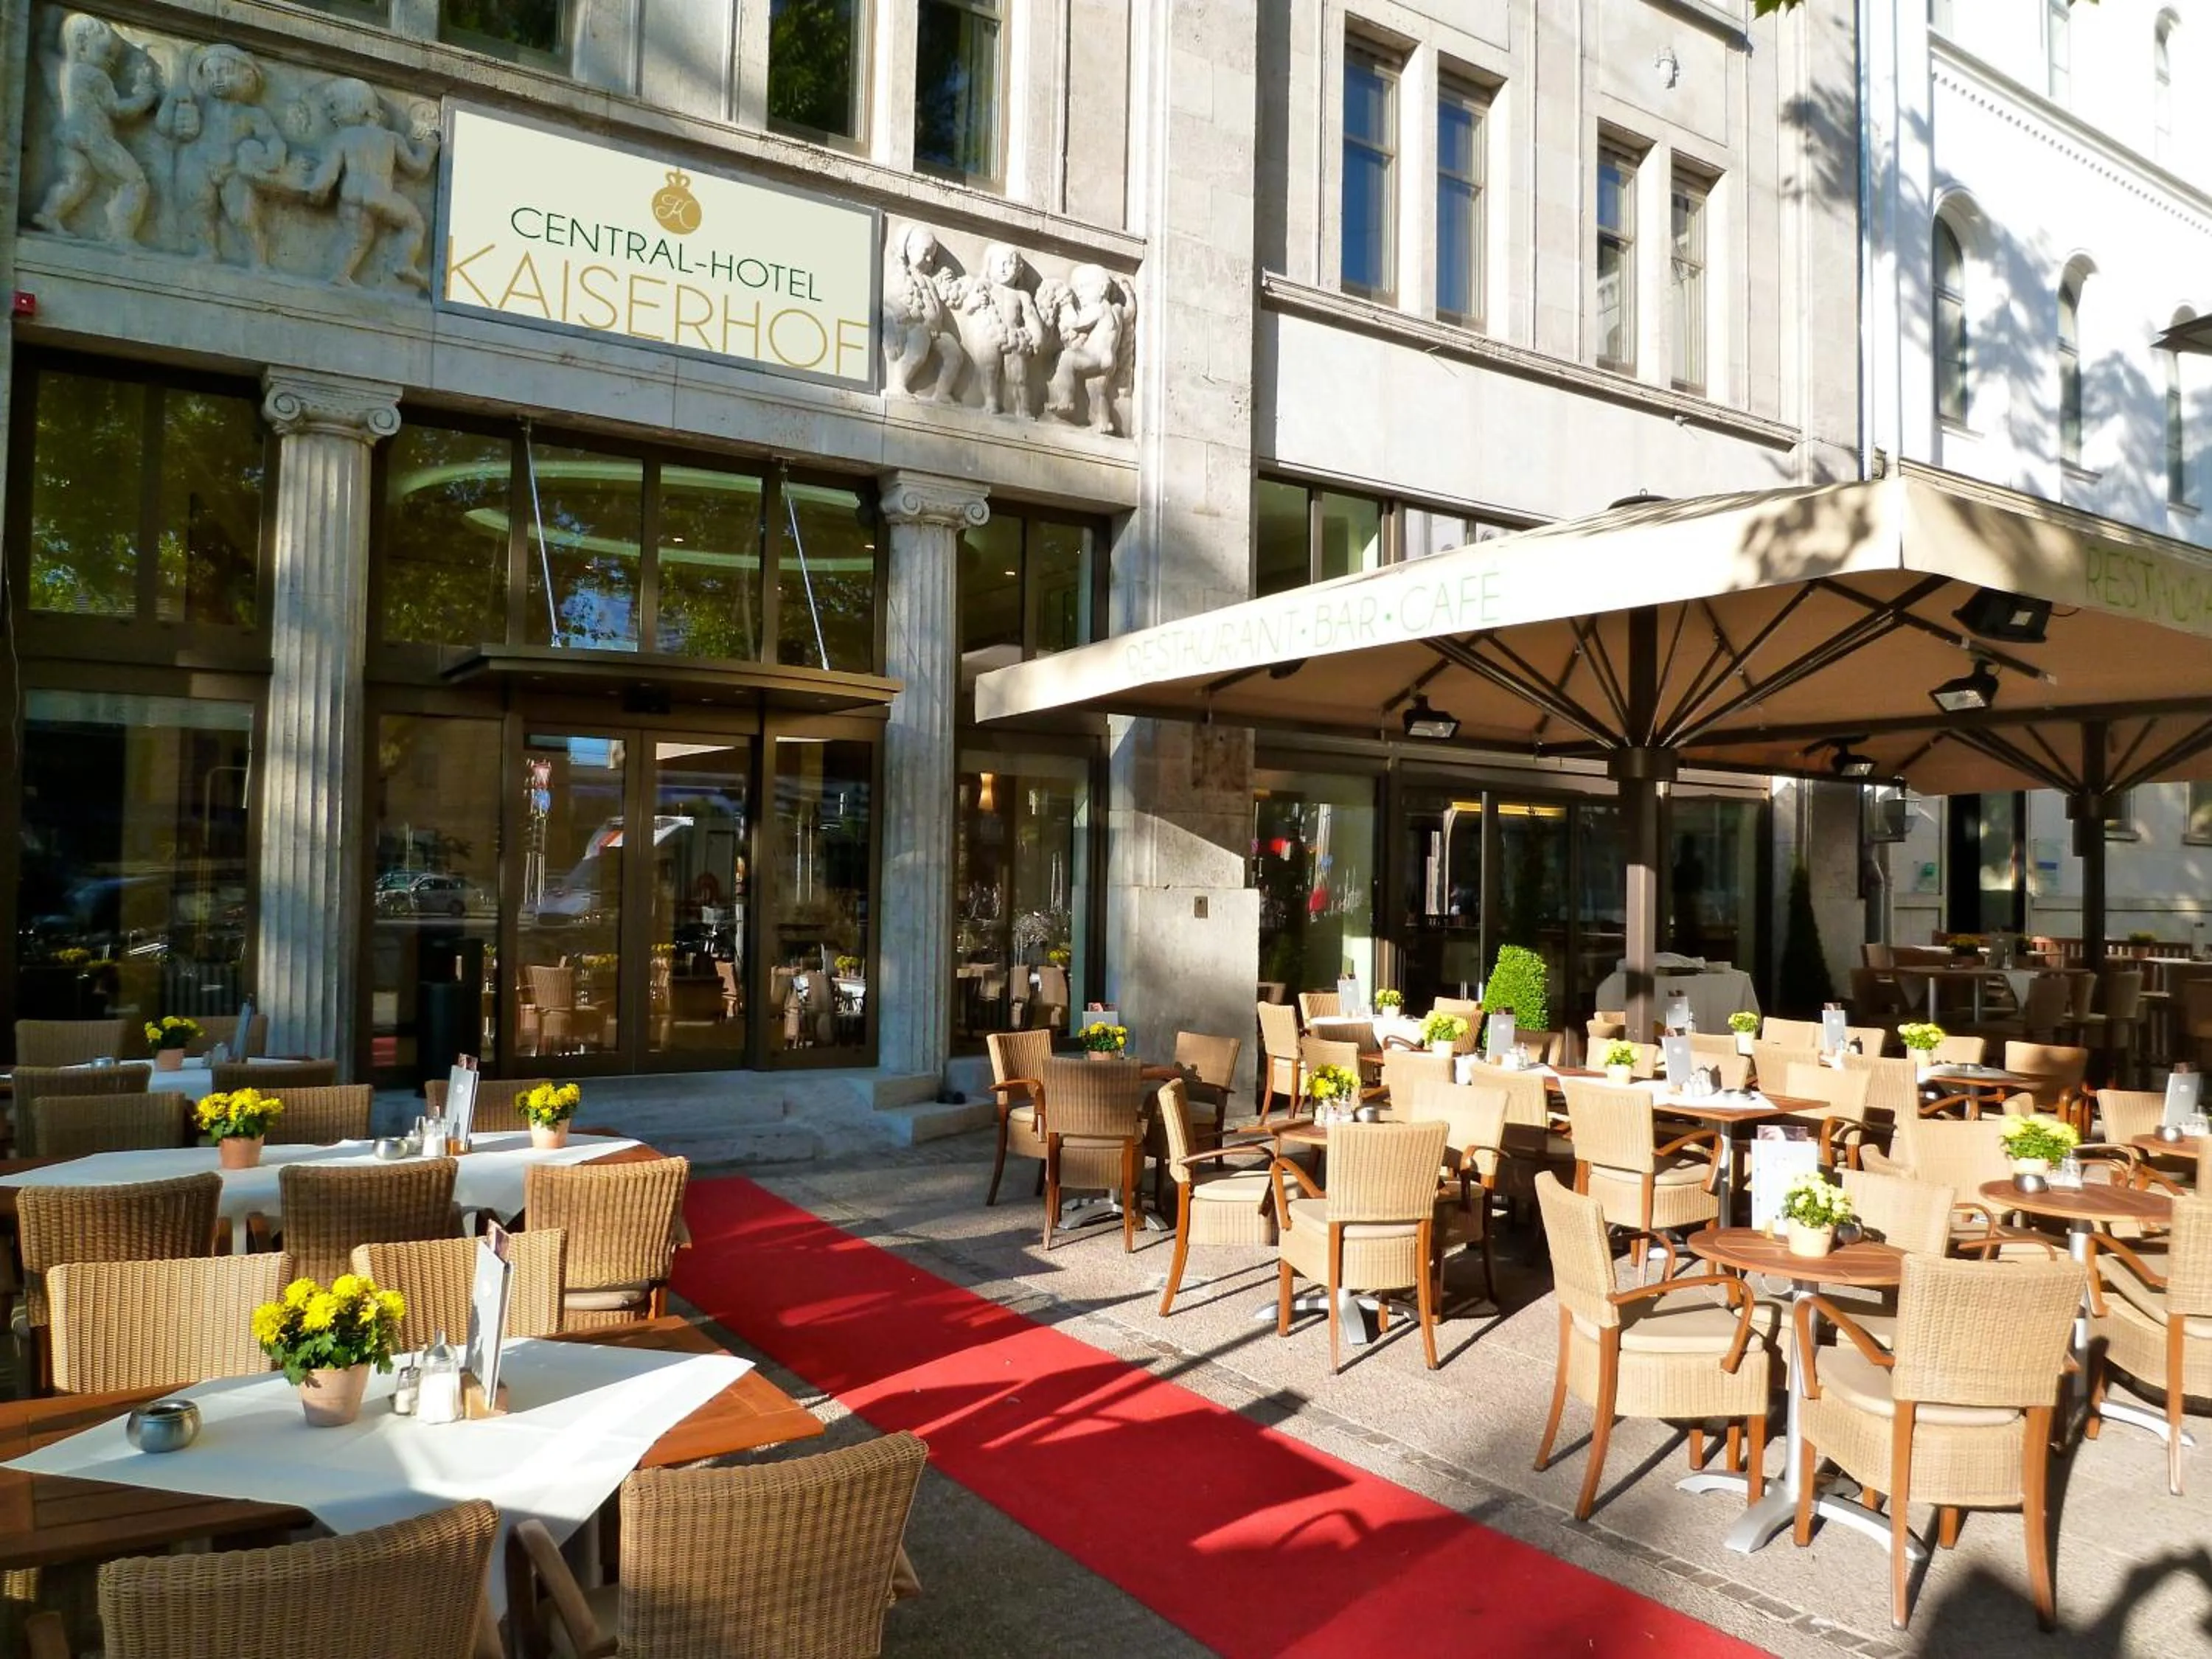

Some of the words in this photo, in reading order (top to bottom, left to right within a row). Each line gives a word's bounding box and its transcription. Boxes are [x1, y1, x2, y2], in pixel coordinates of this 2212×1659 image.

[511, 206, 822, 302] CENTRAL-HOTEL
[445, 235, 873, 375] KAISERHOF
[1314, 596, 1377, 648] BAR
